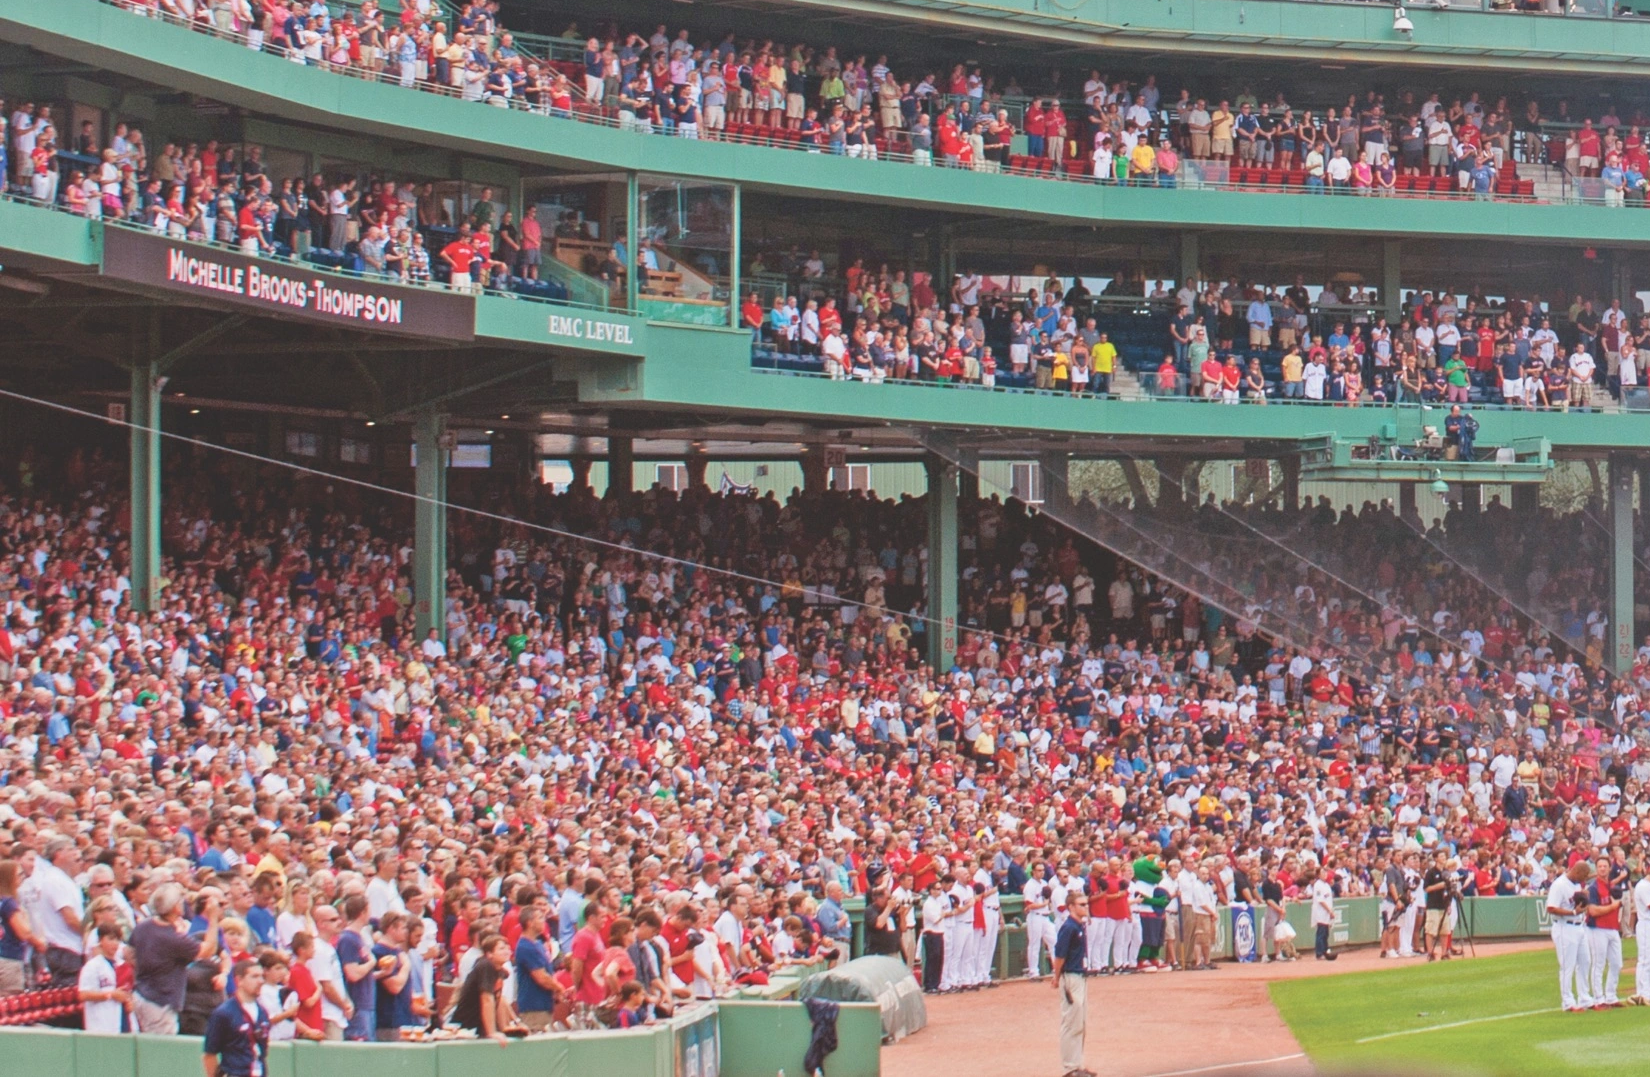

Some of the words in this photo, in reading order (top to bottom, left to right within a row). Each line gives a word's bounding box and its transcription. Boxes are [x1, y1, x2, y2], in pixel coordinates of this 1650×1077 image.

[168, 248, 245, 294] MICHELLE
[248, 264, 402, 324] BROOKS-THOMPSON
[549, 315, 583, 338] EMC
[585, 320, 634, 345] LEVEL
